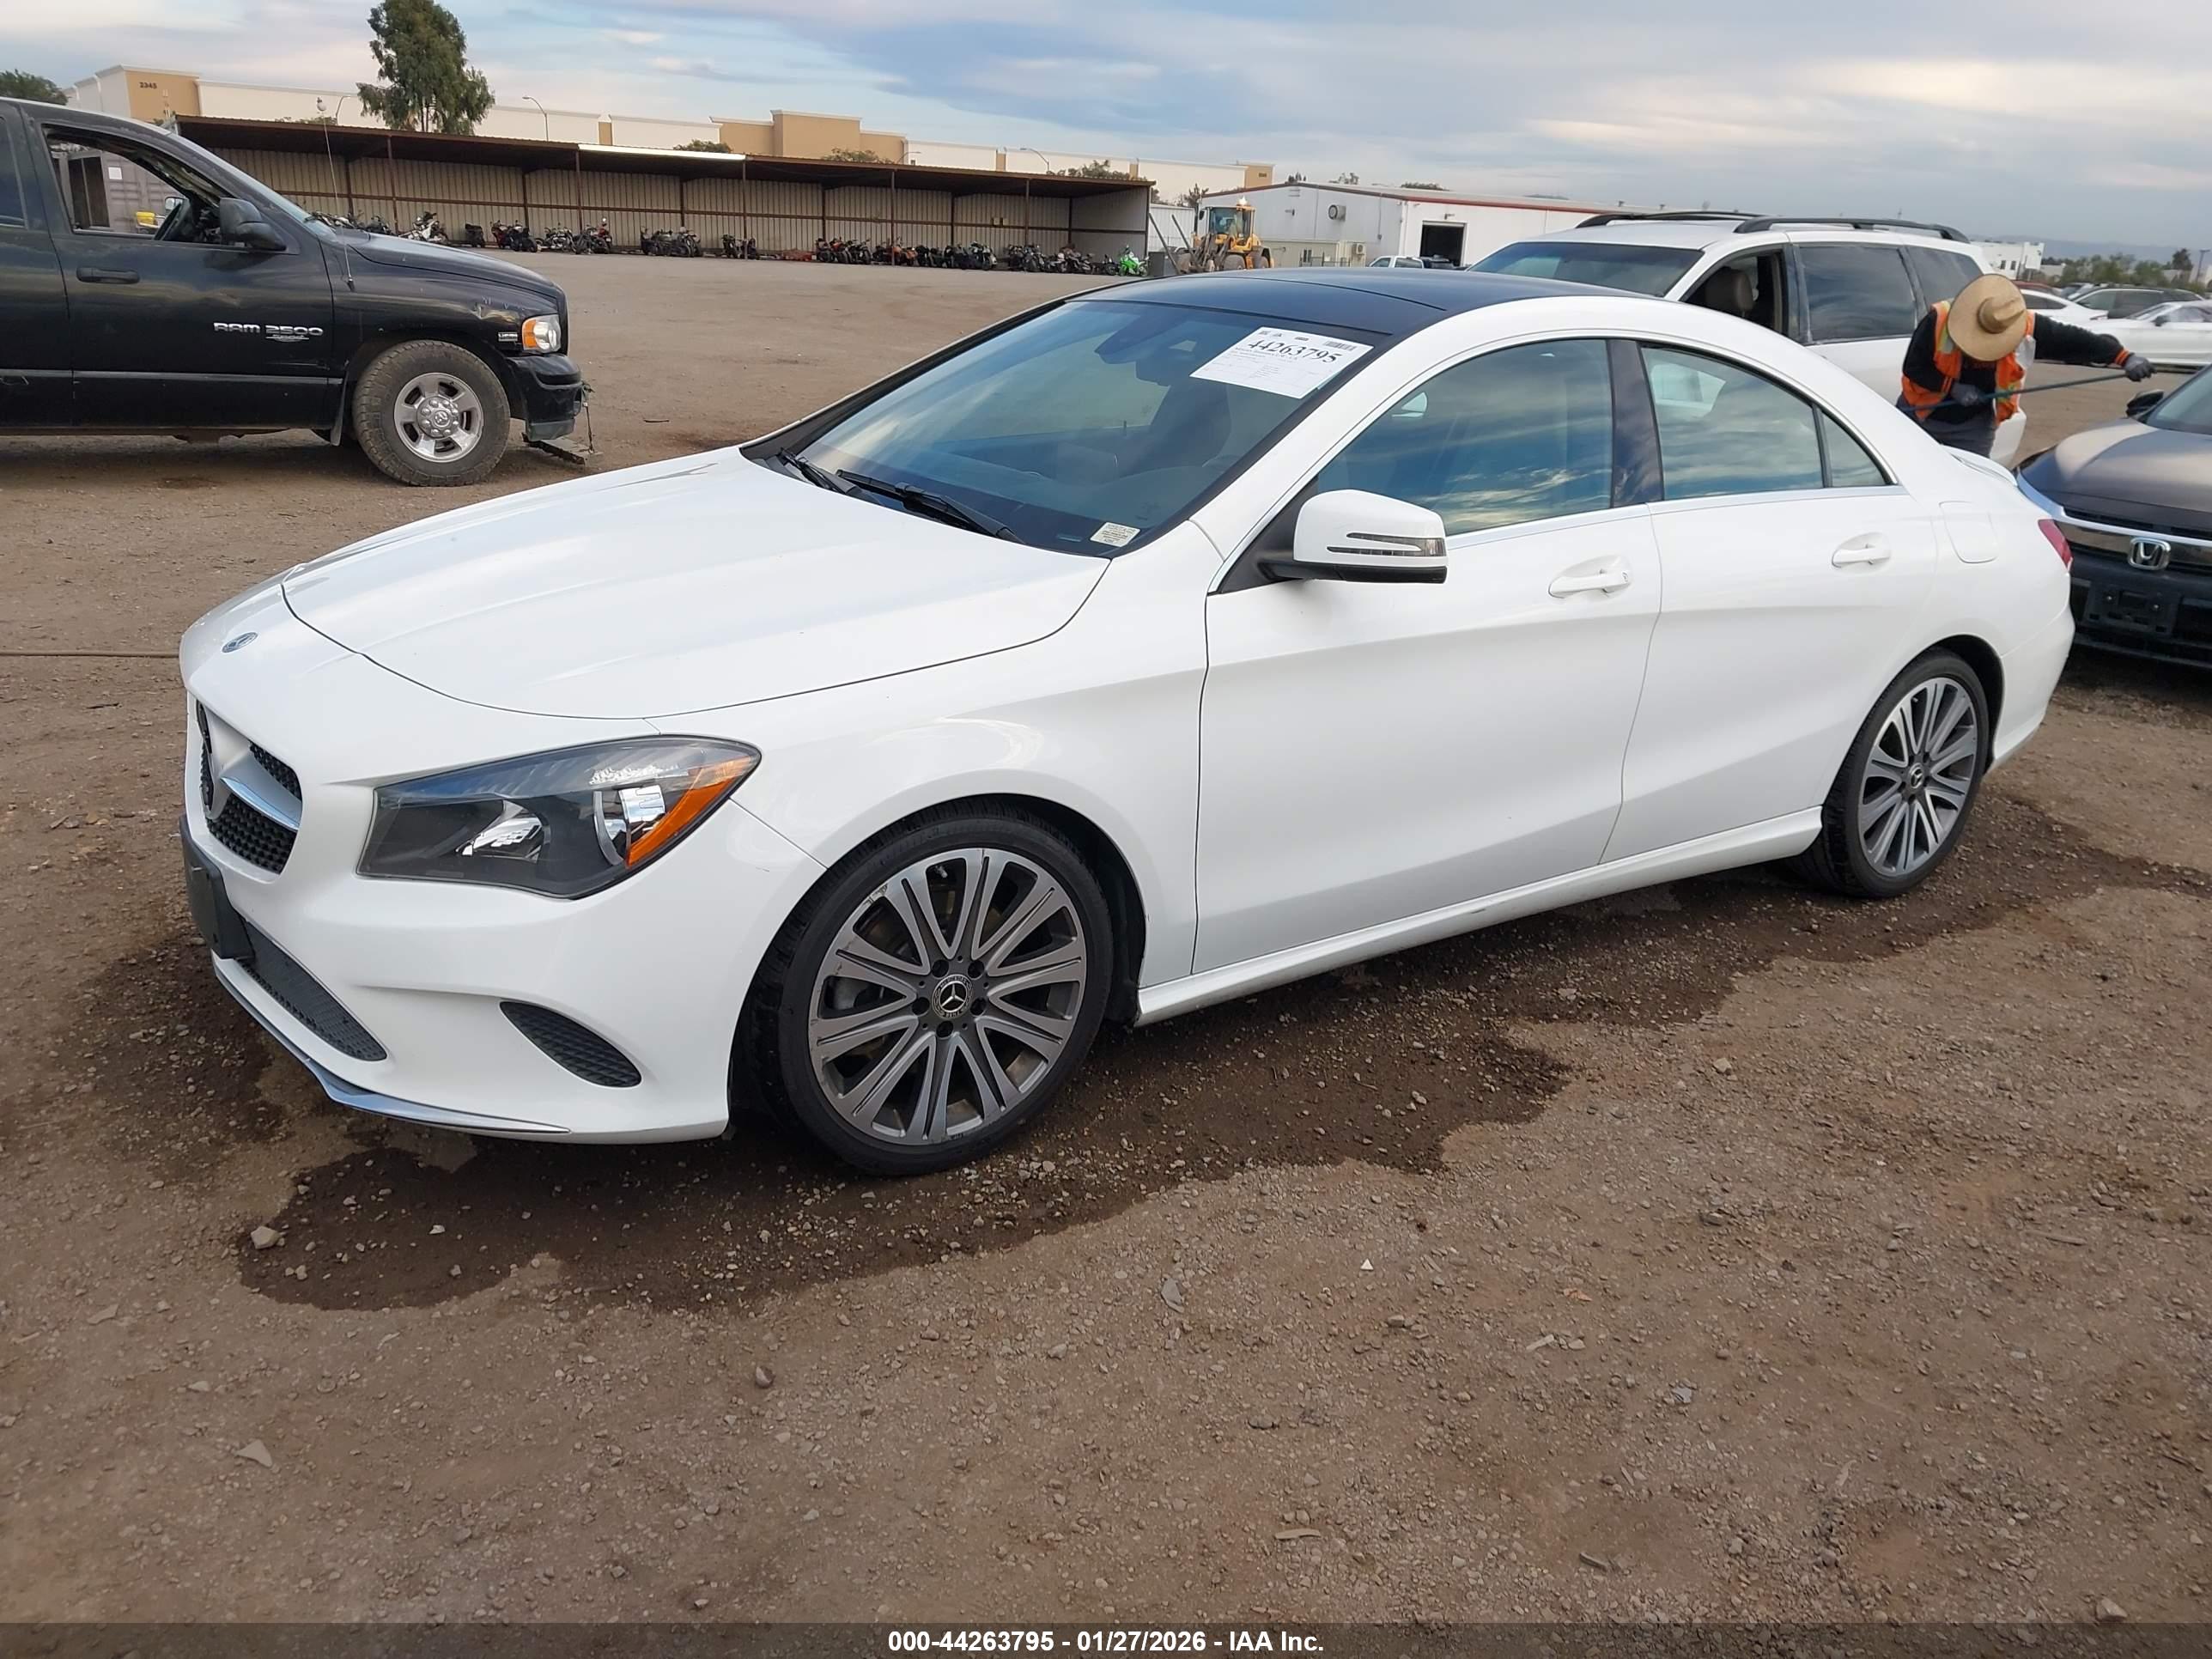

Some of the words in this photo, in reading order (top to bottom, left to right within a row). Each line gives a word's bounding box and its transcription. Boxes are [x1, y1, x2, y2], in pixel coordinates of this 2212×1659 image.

[213, 322, 261, 333] RAM
[265, 325, 324, 336] 2500
[1248, 339, 1343, 363] 44263795
